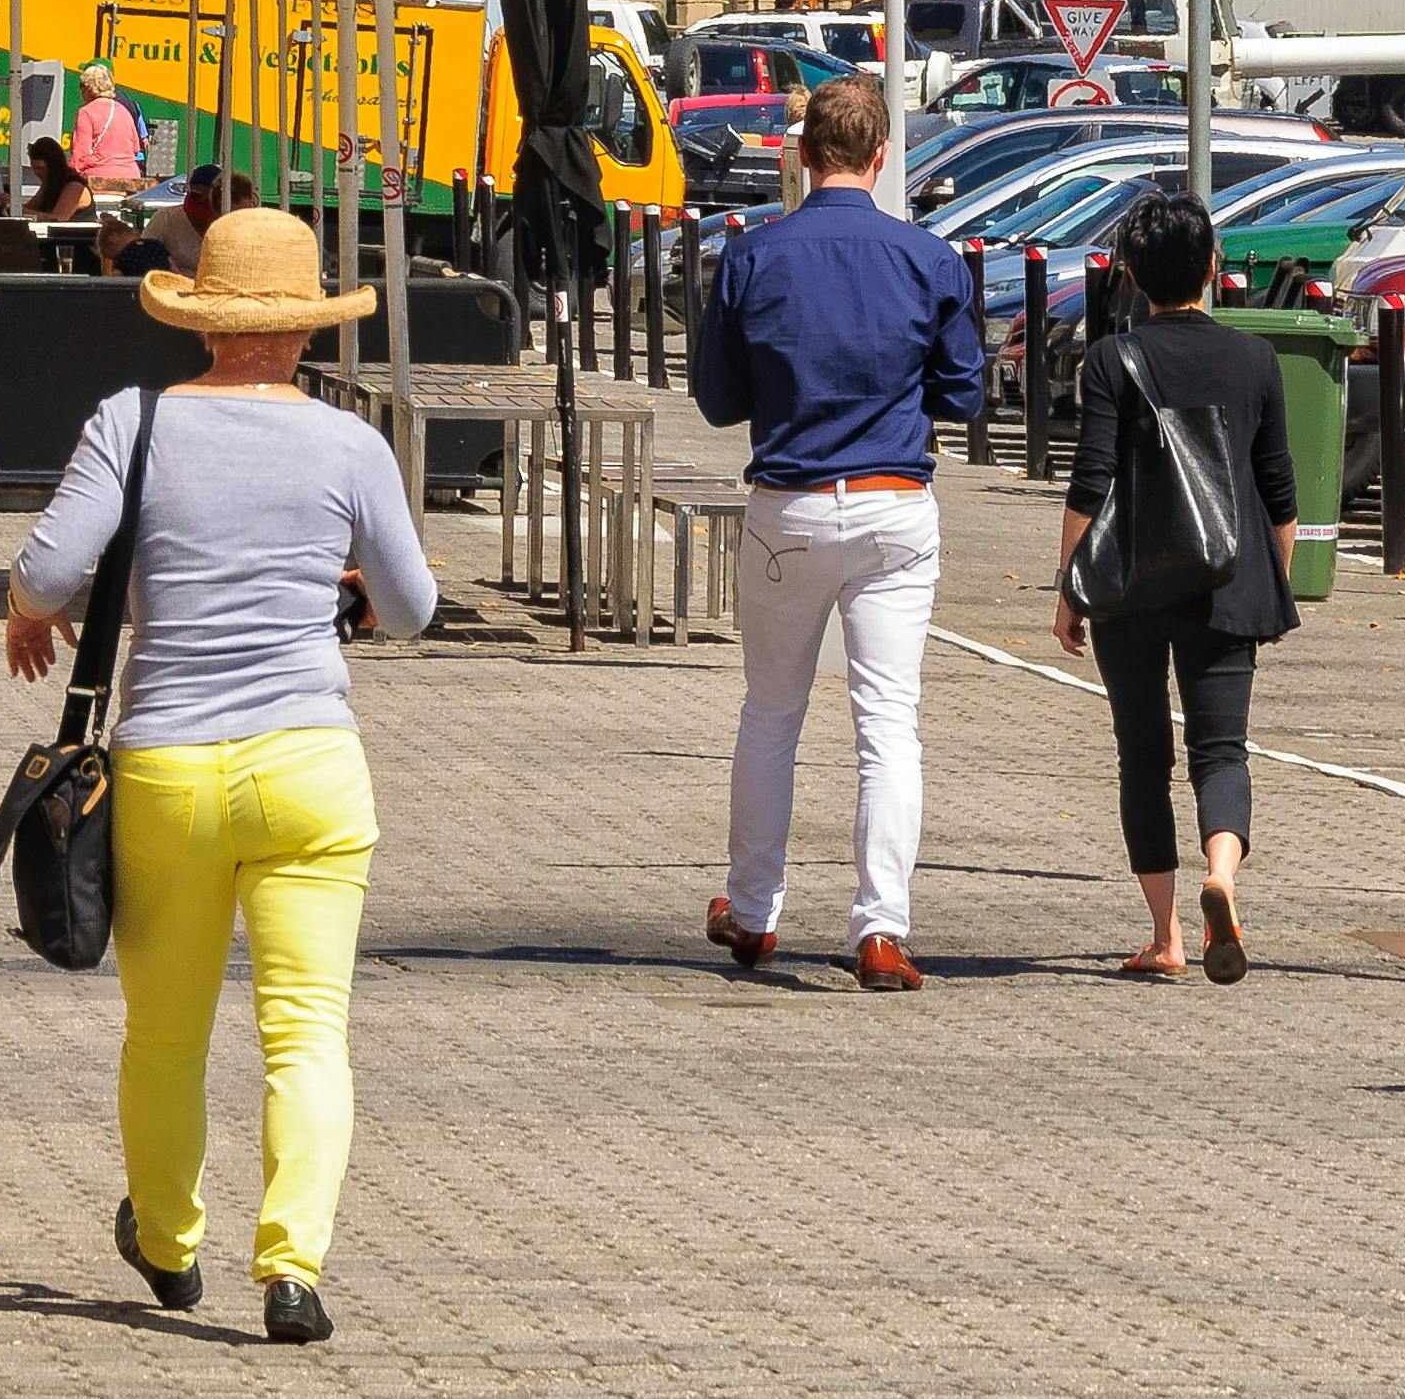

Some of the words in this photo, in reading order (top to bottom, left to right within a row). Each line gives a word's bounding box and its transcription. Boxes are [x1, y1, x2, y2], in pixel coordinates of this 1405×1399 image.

[1067, 11, 1103, 25] GIVE
[1072, 26, 1096, 38] WAY
[112, 35, 182, 63] Fruit
[198, 42, 221, 65] &
